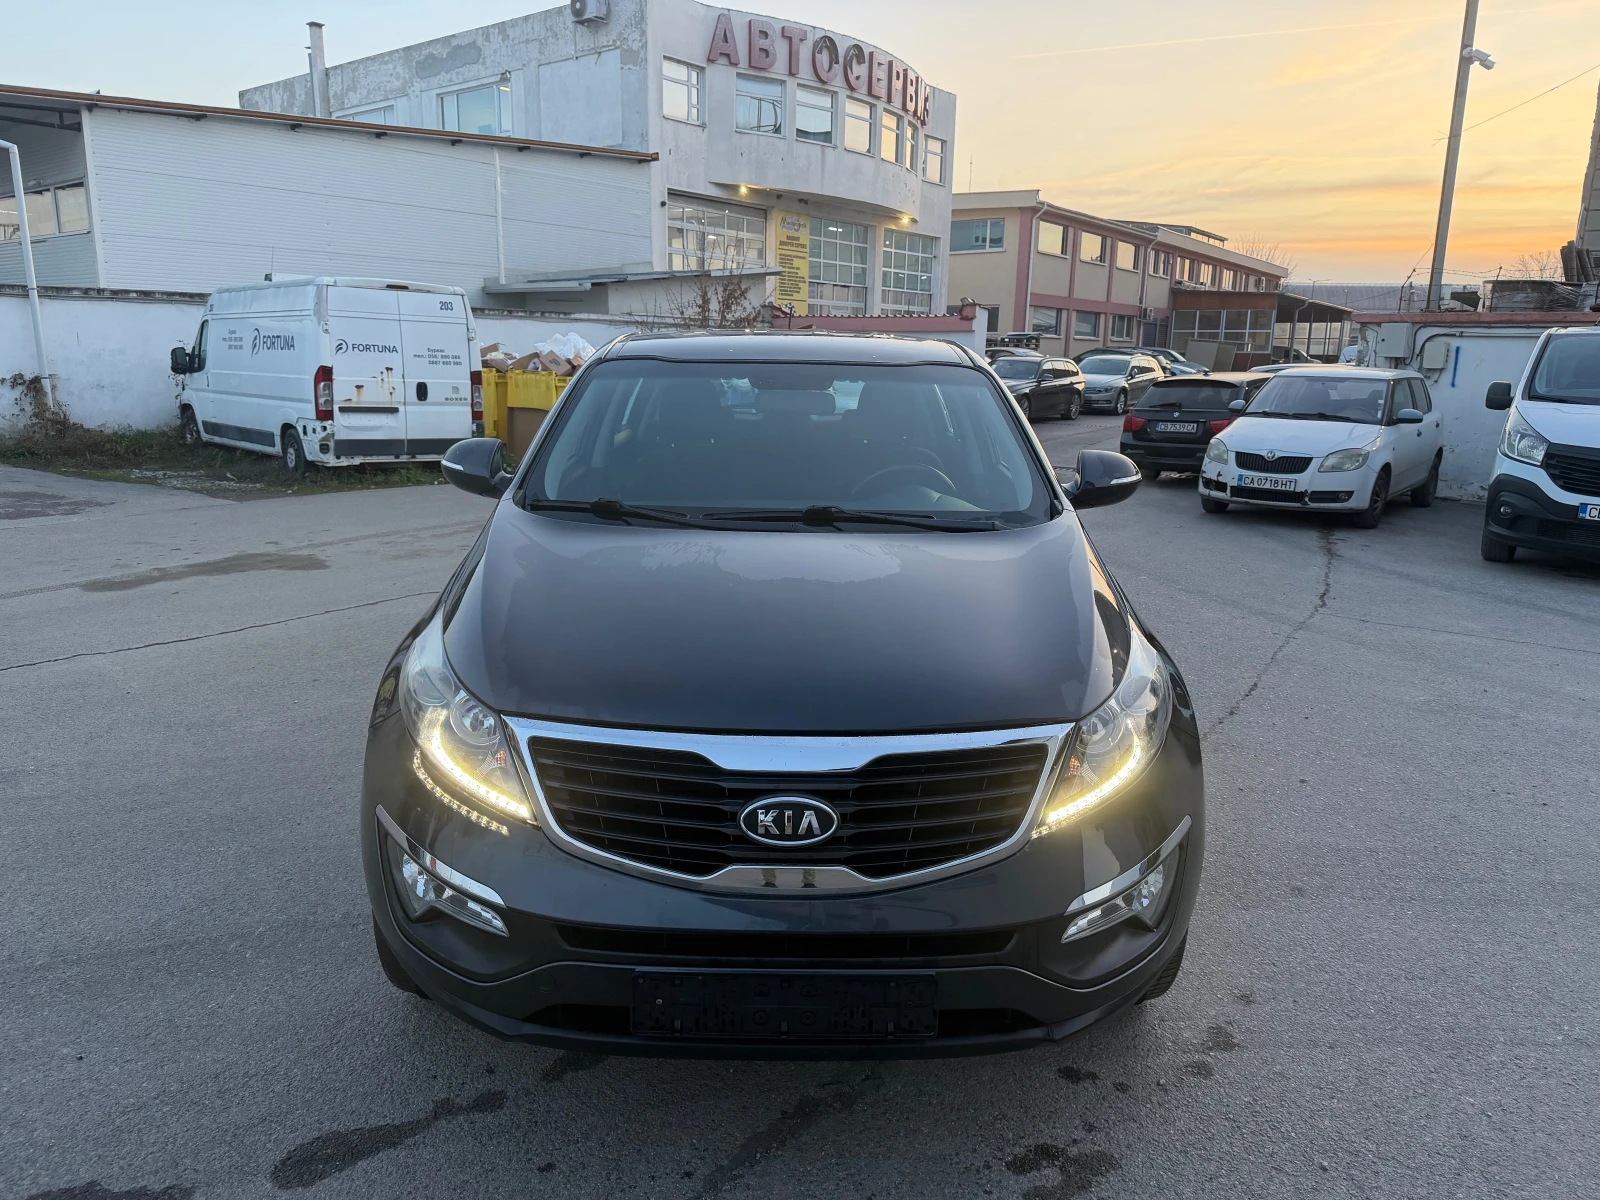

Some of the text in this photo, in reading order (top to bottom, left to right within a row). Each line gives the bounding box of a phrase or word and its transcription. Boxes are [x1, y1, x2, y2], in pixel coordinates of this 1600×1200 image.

[708, 13, 929, 126] АВТОСЕРВИЗ
[439, 301, 453, 311] 203
[262, 335, 295, 351] FORTUNA
[352, 343, 398, 353] FORTUNA
[1169, 423, 1186, 431] 7539
[1186, 424, 1195, 432] CA
[1243, 476, 1293, 490] CA 0718 HT
[757, 810, 821, 834] KIA
